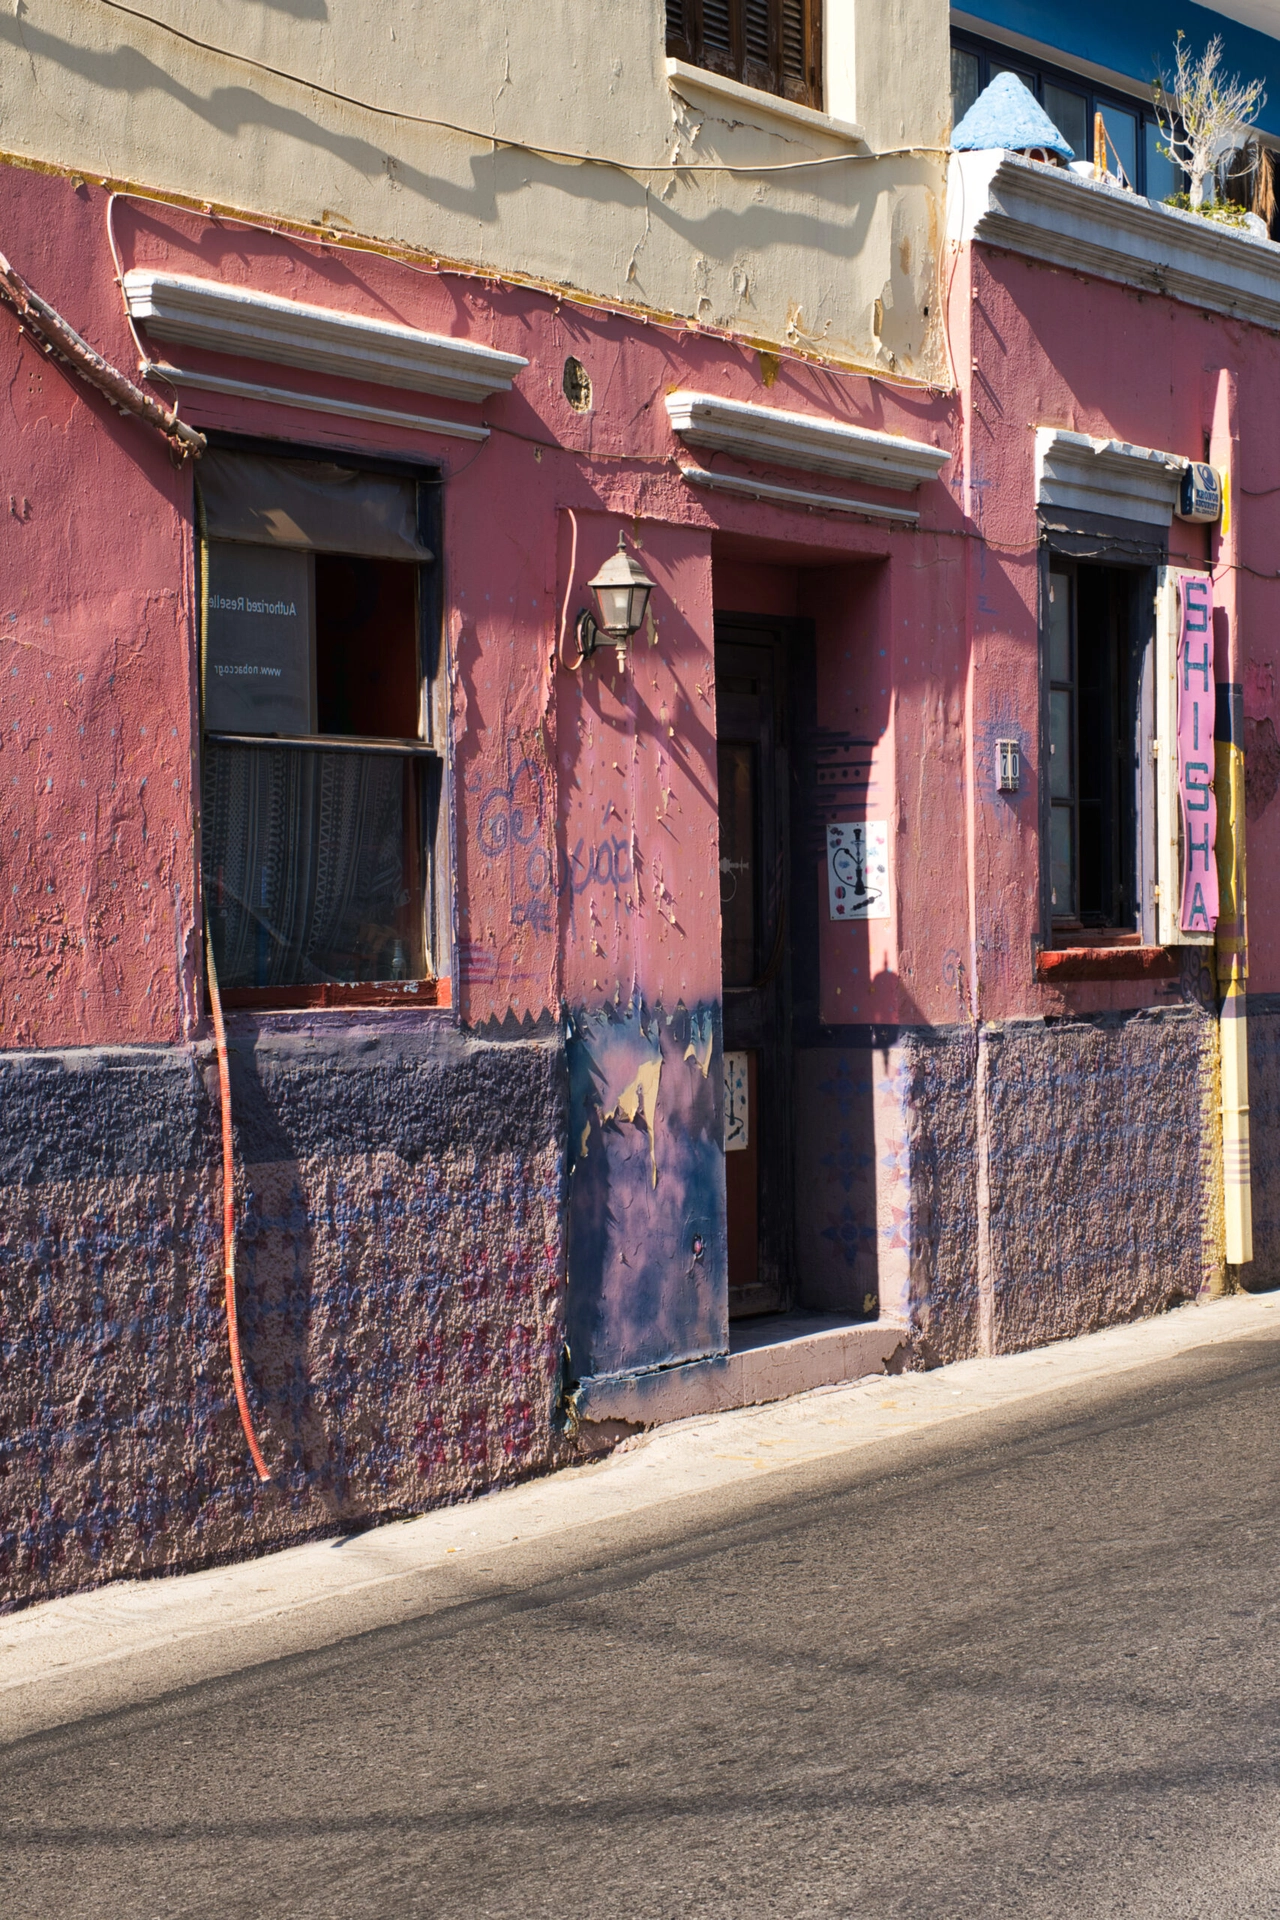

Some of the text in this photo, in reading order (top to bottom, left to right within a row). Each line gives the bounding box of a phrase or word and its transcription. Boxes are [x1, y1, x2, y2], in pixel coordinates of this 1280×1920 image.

[1195, 499, 1218, 511] SECURITY
[1196, 489, 1219, 503] KRONOS
[1184, 581, 1210, 930] SHISHA
[1002, 754, 1019, 777] 70
